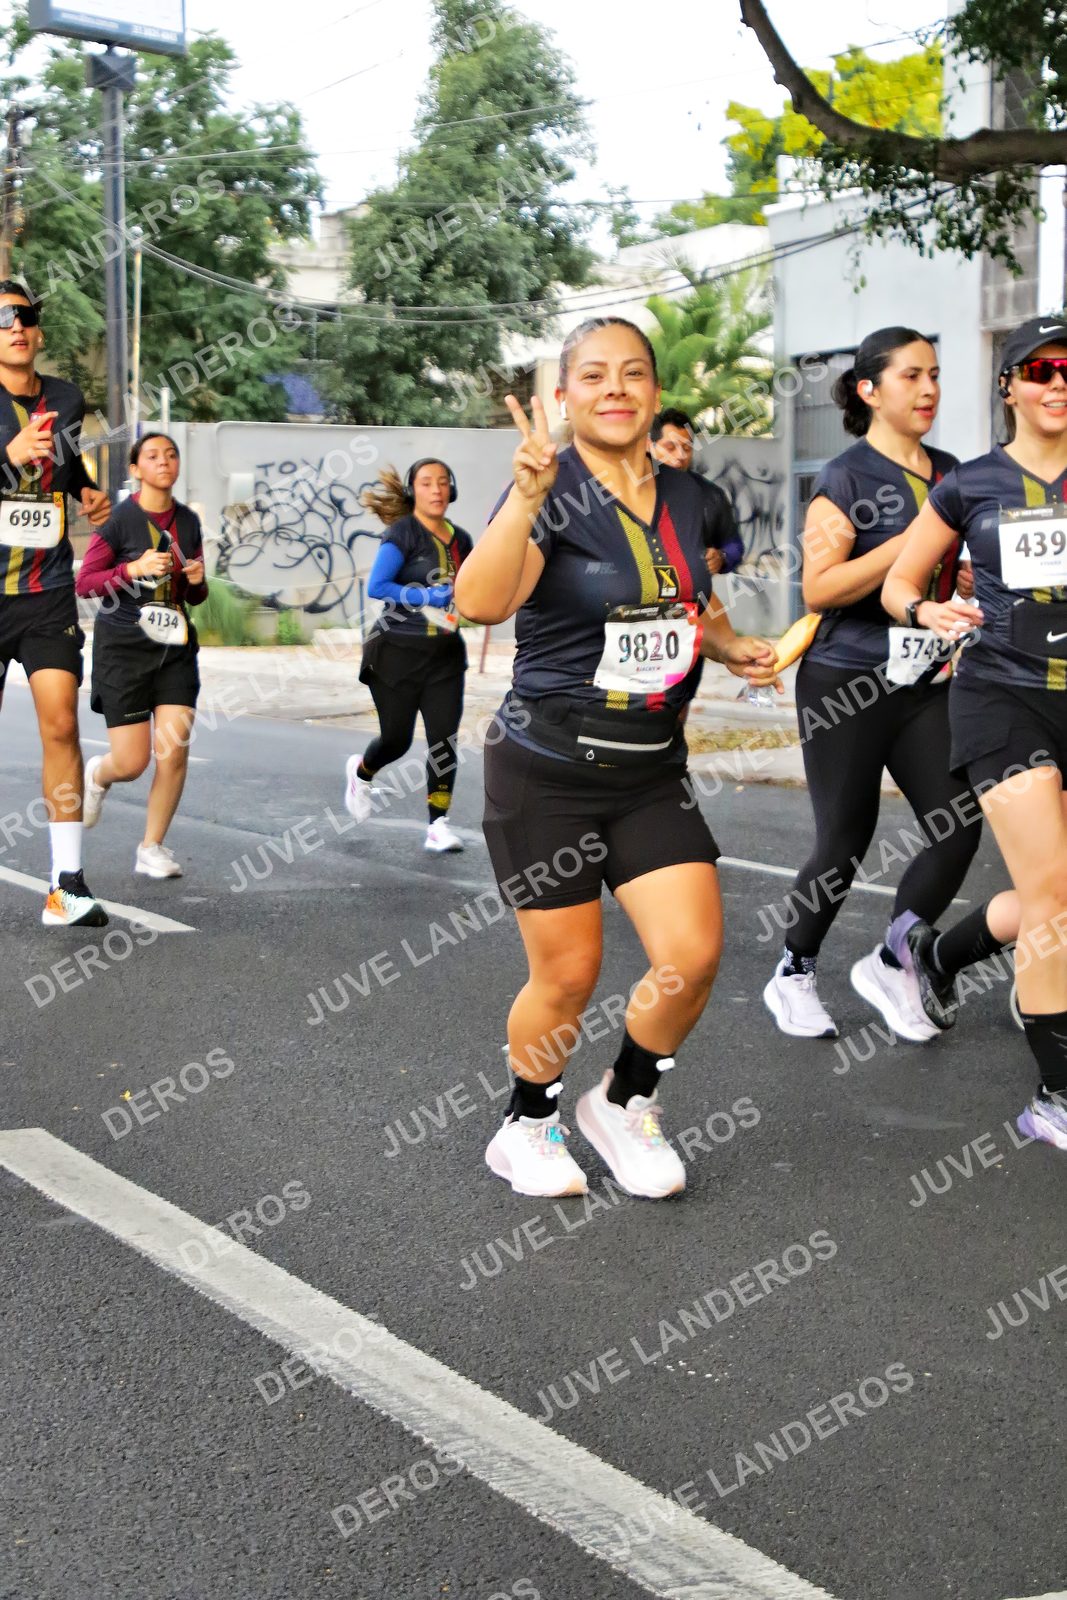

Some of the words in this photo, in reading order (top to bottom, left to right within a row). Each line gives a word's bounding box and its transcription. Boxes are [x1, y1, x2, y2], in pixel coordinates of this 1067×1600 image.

[9, 509, 52, 528] 6995
[1015, 530, 1067, 558] 439
[148, 610, 179, 629] 4134
[618, 630, 680, 663] 9820
